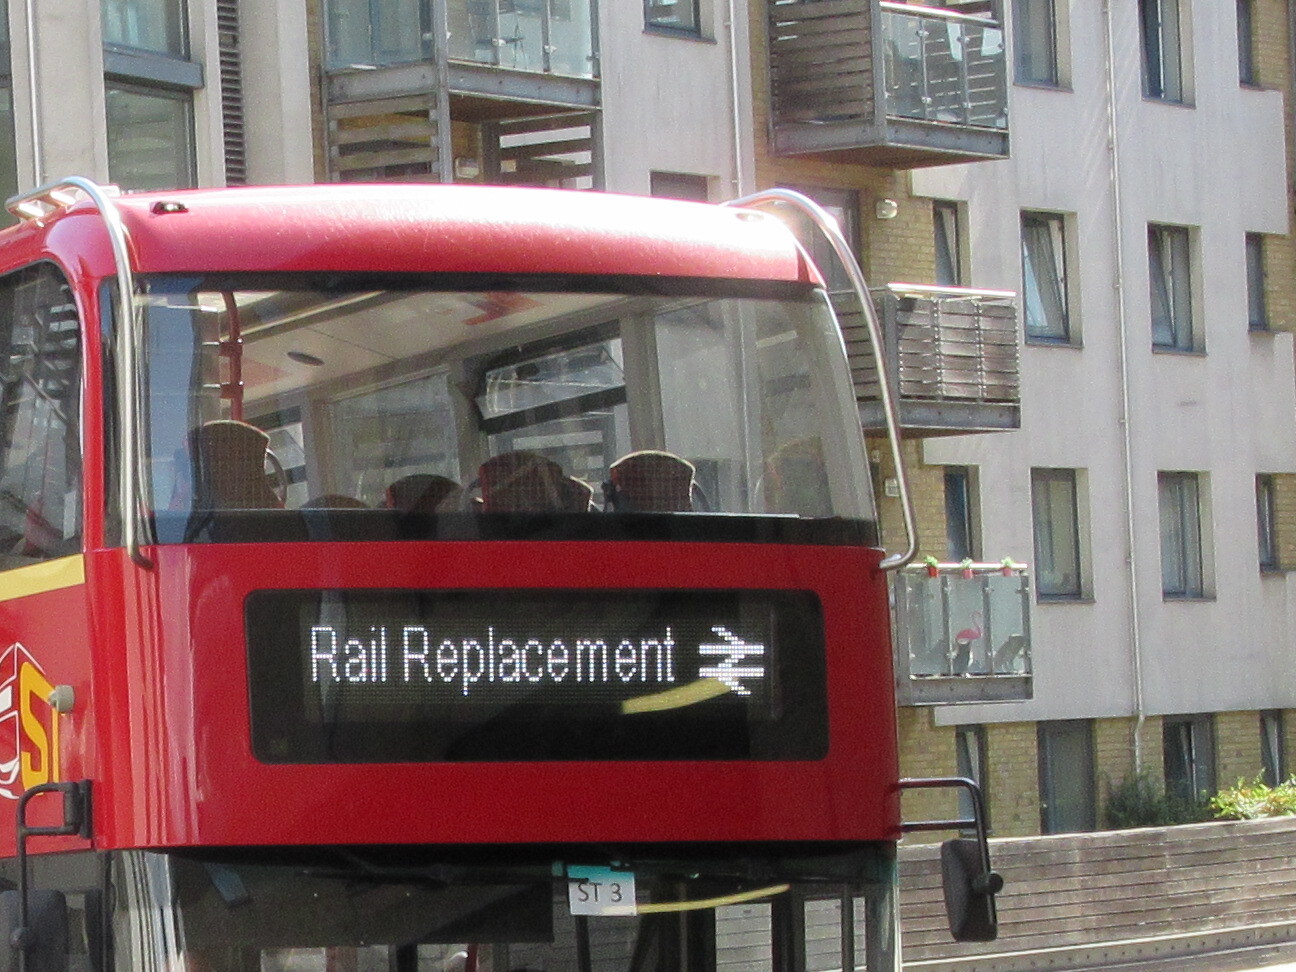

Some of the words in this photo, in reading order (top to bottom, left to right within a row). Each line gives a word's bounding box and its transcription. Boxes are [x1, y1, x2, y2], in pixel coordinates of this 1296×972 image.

[311, 626, 387, 683] Rail
[403, 626, 676, 696] Replacement
[578, 883, 602, 902] ST
[610, 883, 622, 902] 3
